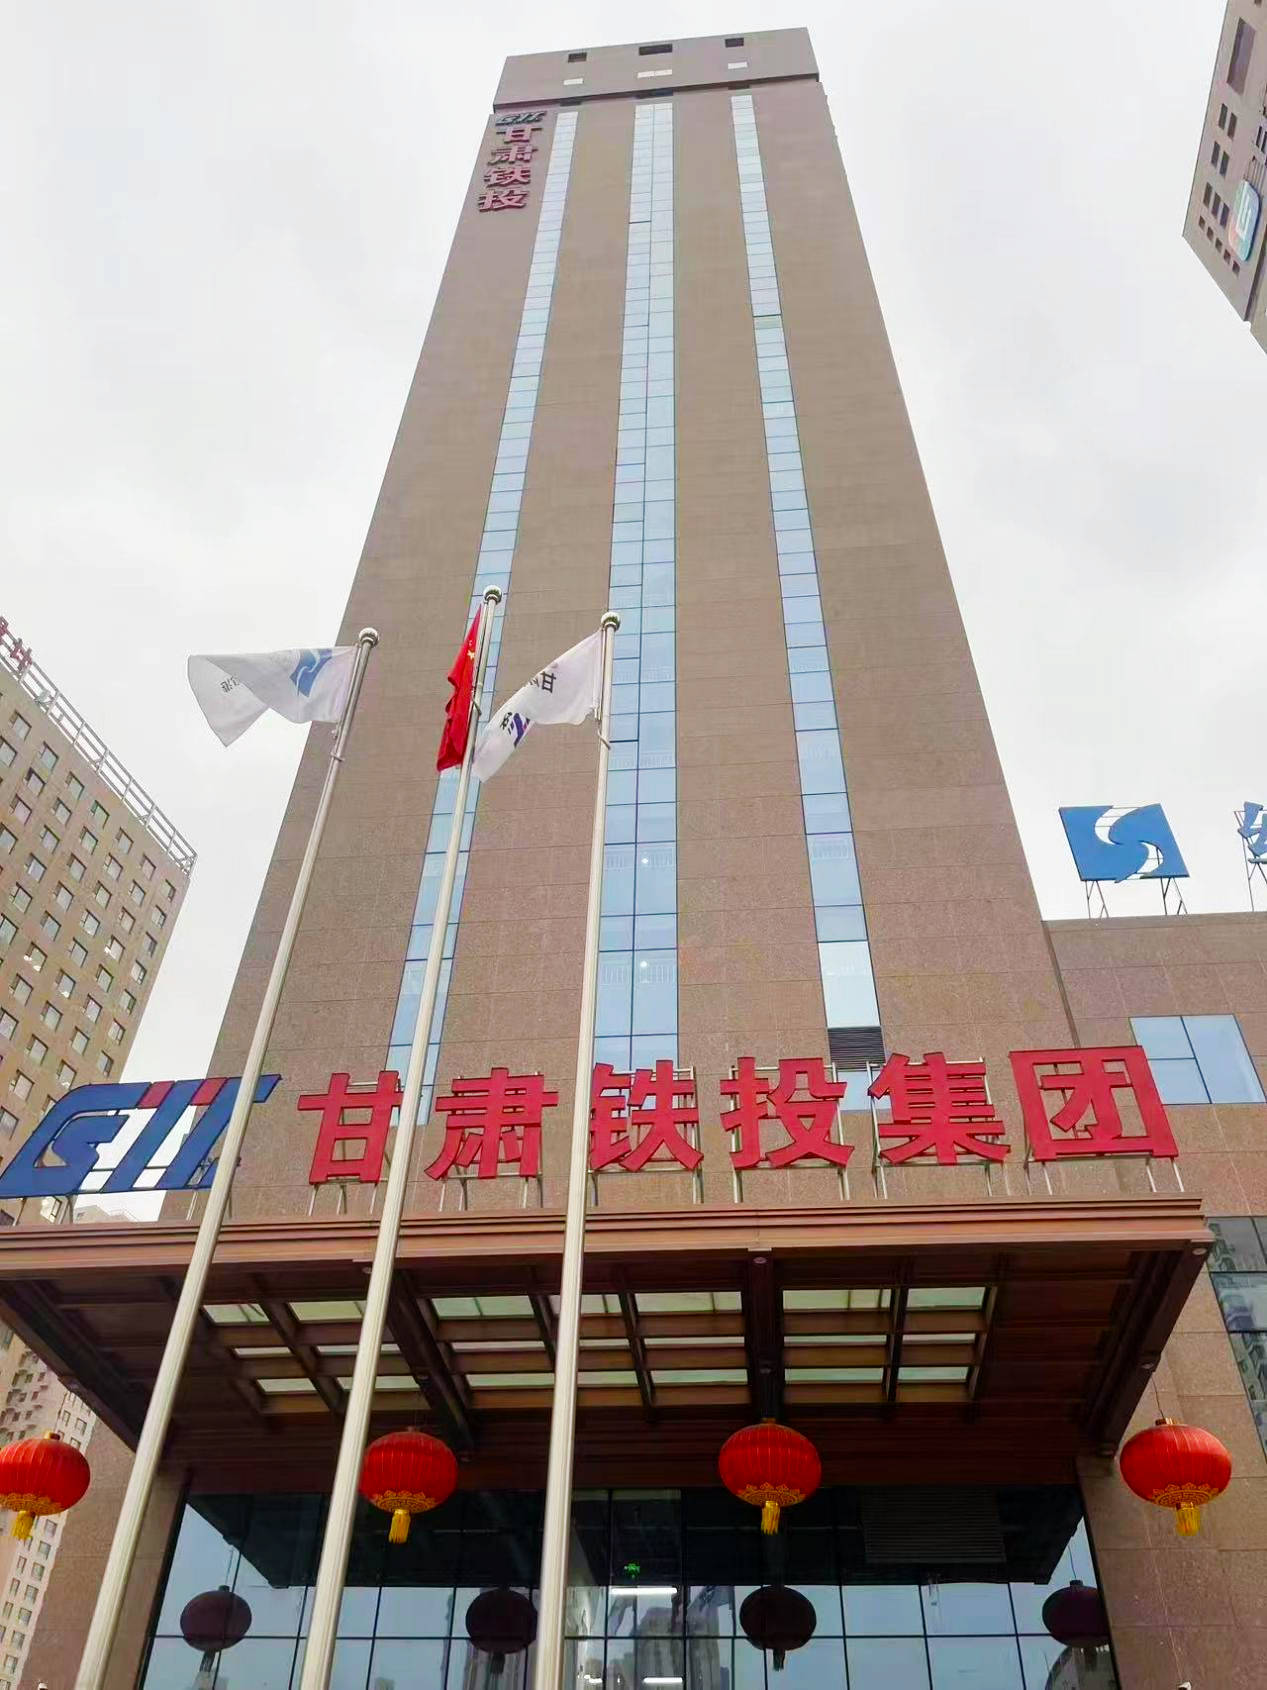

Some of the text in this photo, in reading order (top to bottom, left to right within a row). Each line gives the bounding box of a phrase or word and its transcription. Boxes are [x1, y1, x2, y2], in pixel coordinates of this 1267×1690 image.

[478, 125, 543, 213] 甘肃铁投
[297, 1045, 1179, 1184] 甘肃铁投集团
